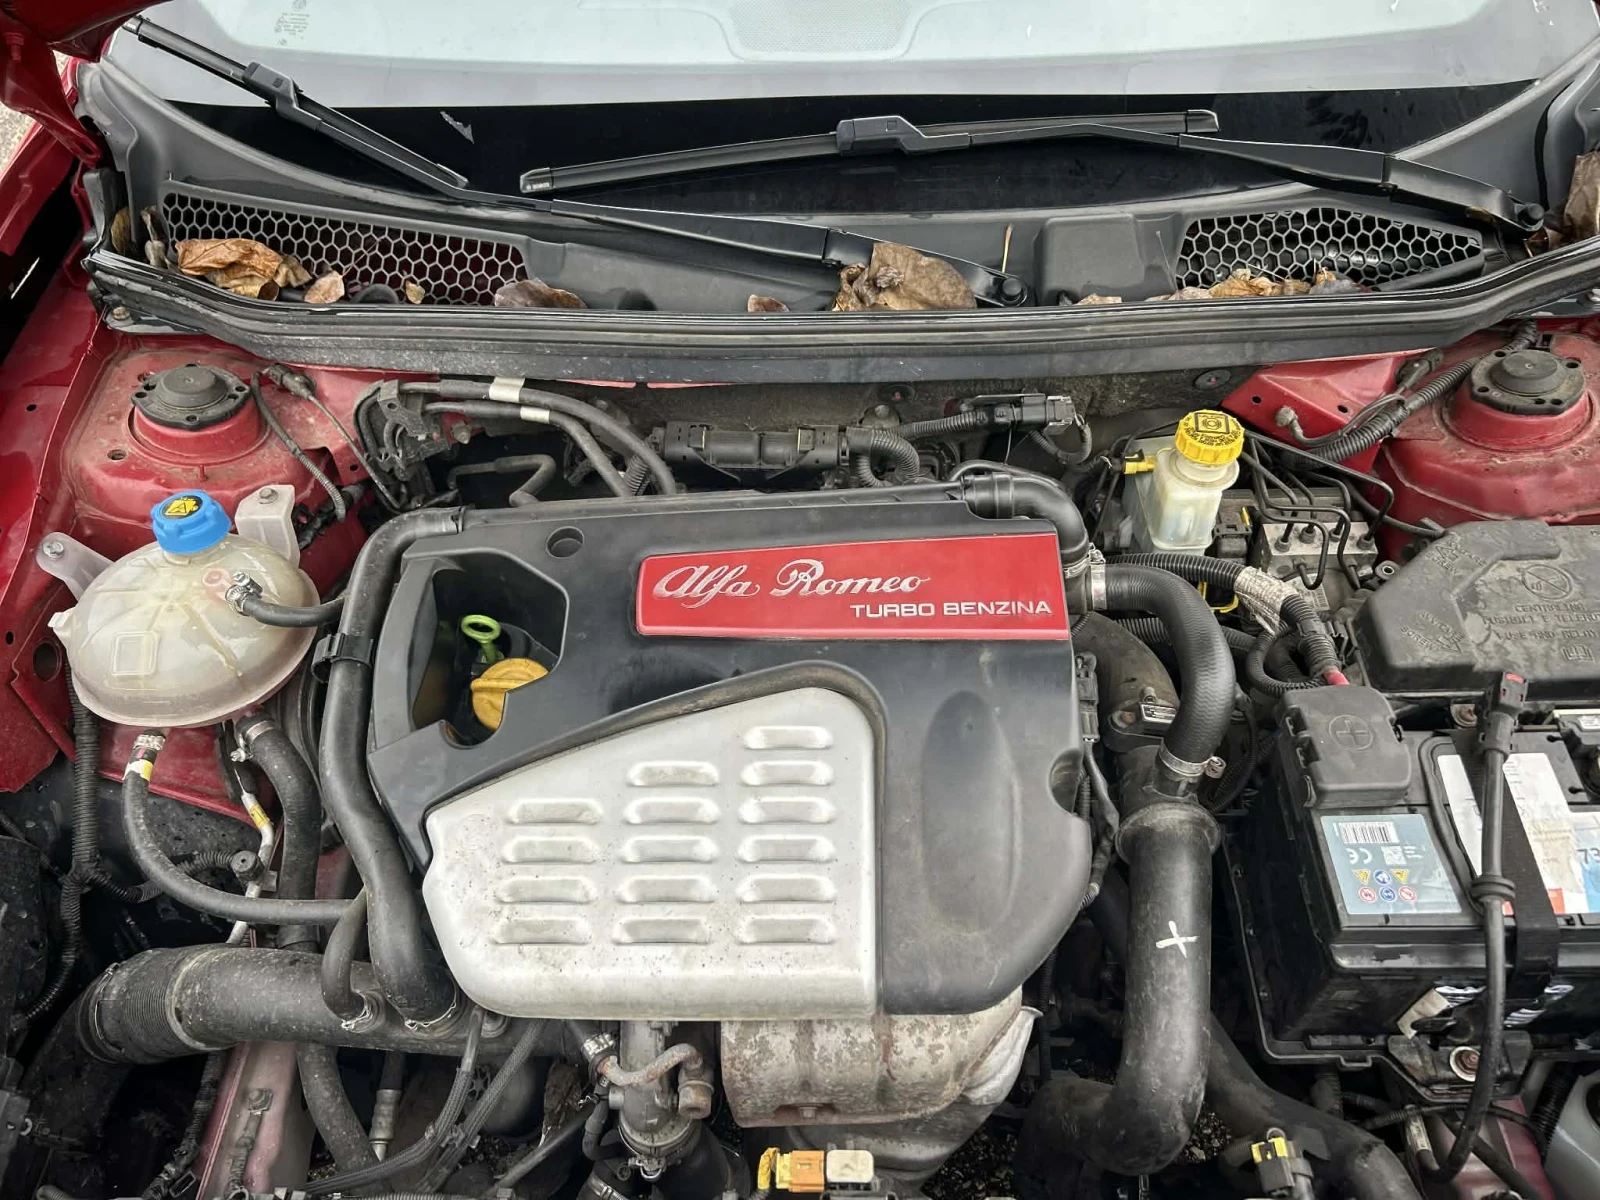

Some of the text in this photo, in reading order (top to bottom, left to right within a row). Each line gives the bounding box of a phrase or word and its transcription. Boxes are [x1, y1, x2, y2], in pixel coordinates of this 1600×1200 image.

[652, 558, 931, 609] Alfa Romeo
[849, 600, 1052, 618] TURBO BENZINA
